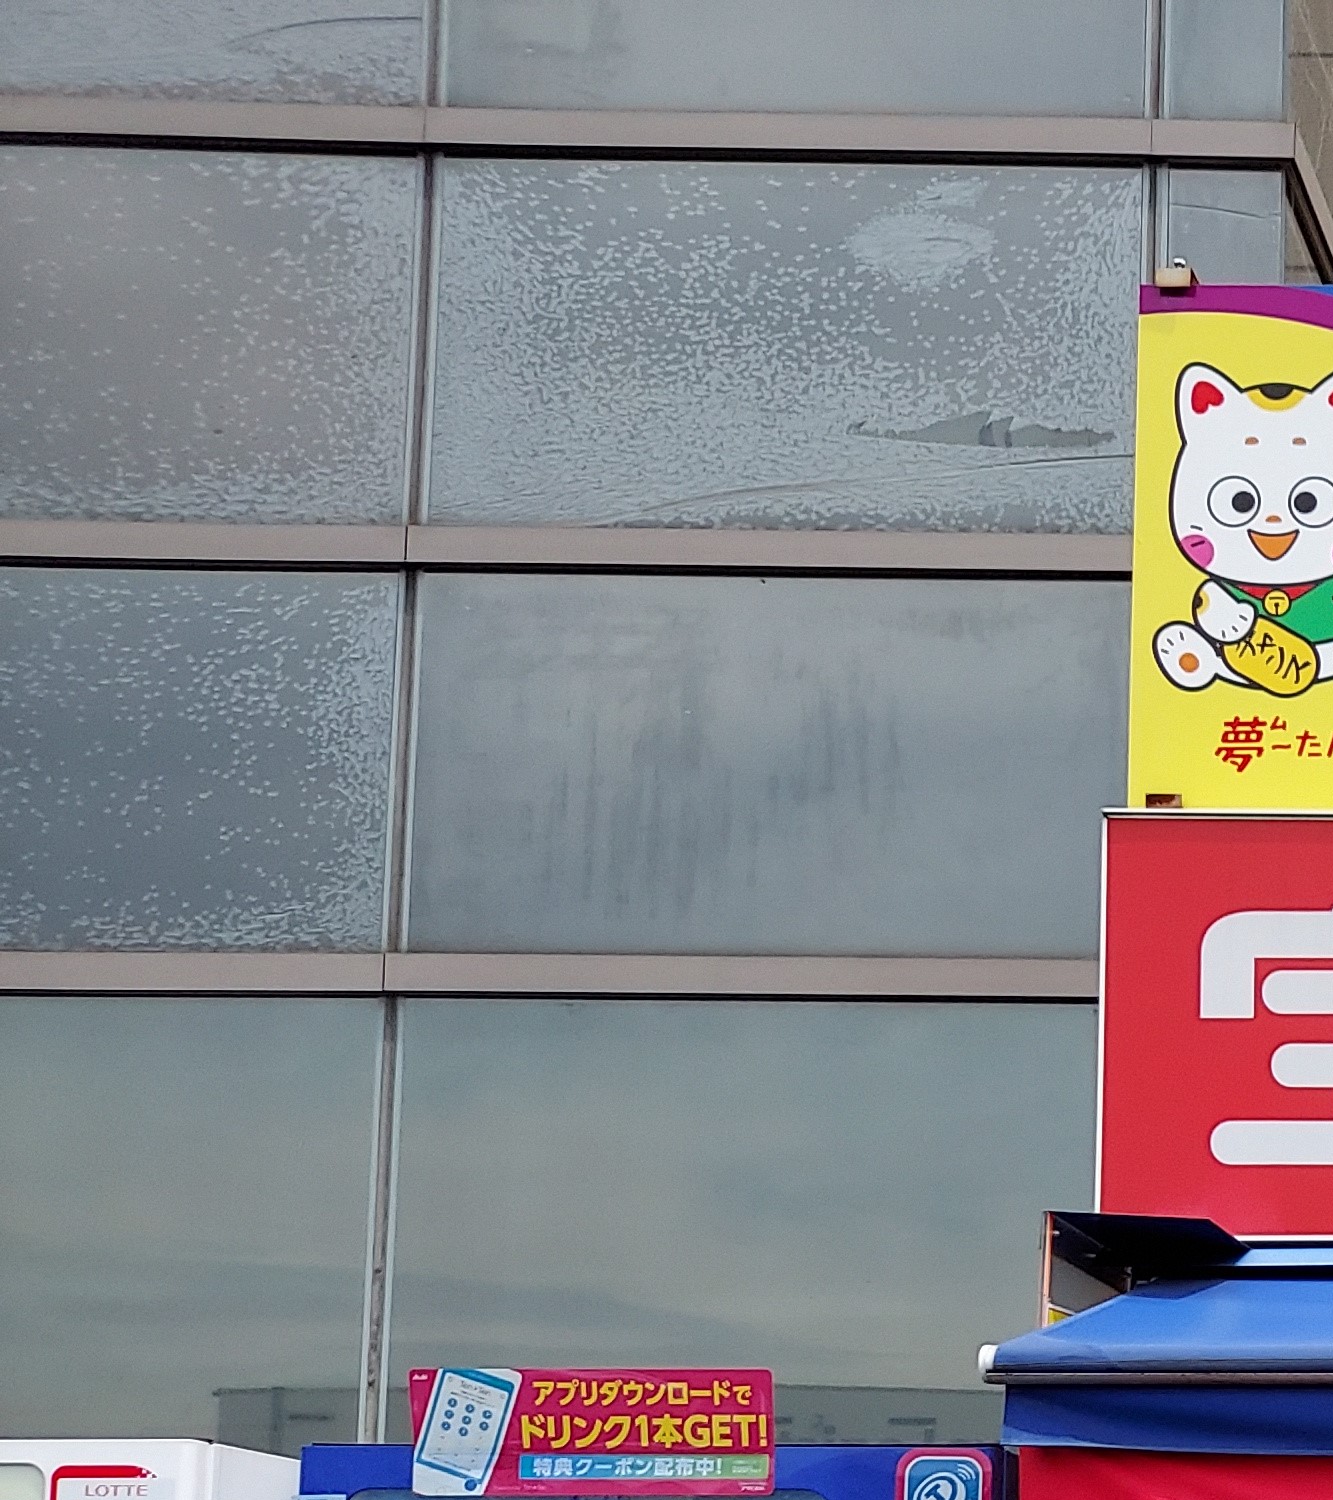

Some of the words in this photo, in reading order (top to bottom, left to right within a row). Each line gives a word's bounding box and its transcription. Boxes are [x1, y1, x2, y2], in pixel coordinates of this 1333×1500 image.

[532, 1380, 752, 1407] アプリダウンロードで
[521, 1414, 770, 1448] ドリンク1本GET!
[532, 1455, 723, 1478] 特典クーポン配布中!
[84, 1484, 148, 1498] LOTTE
